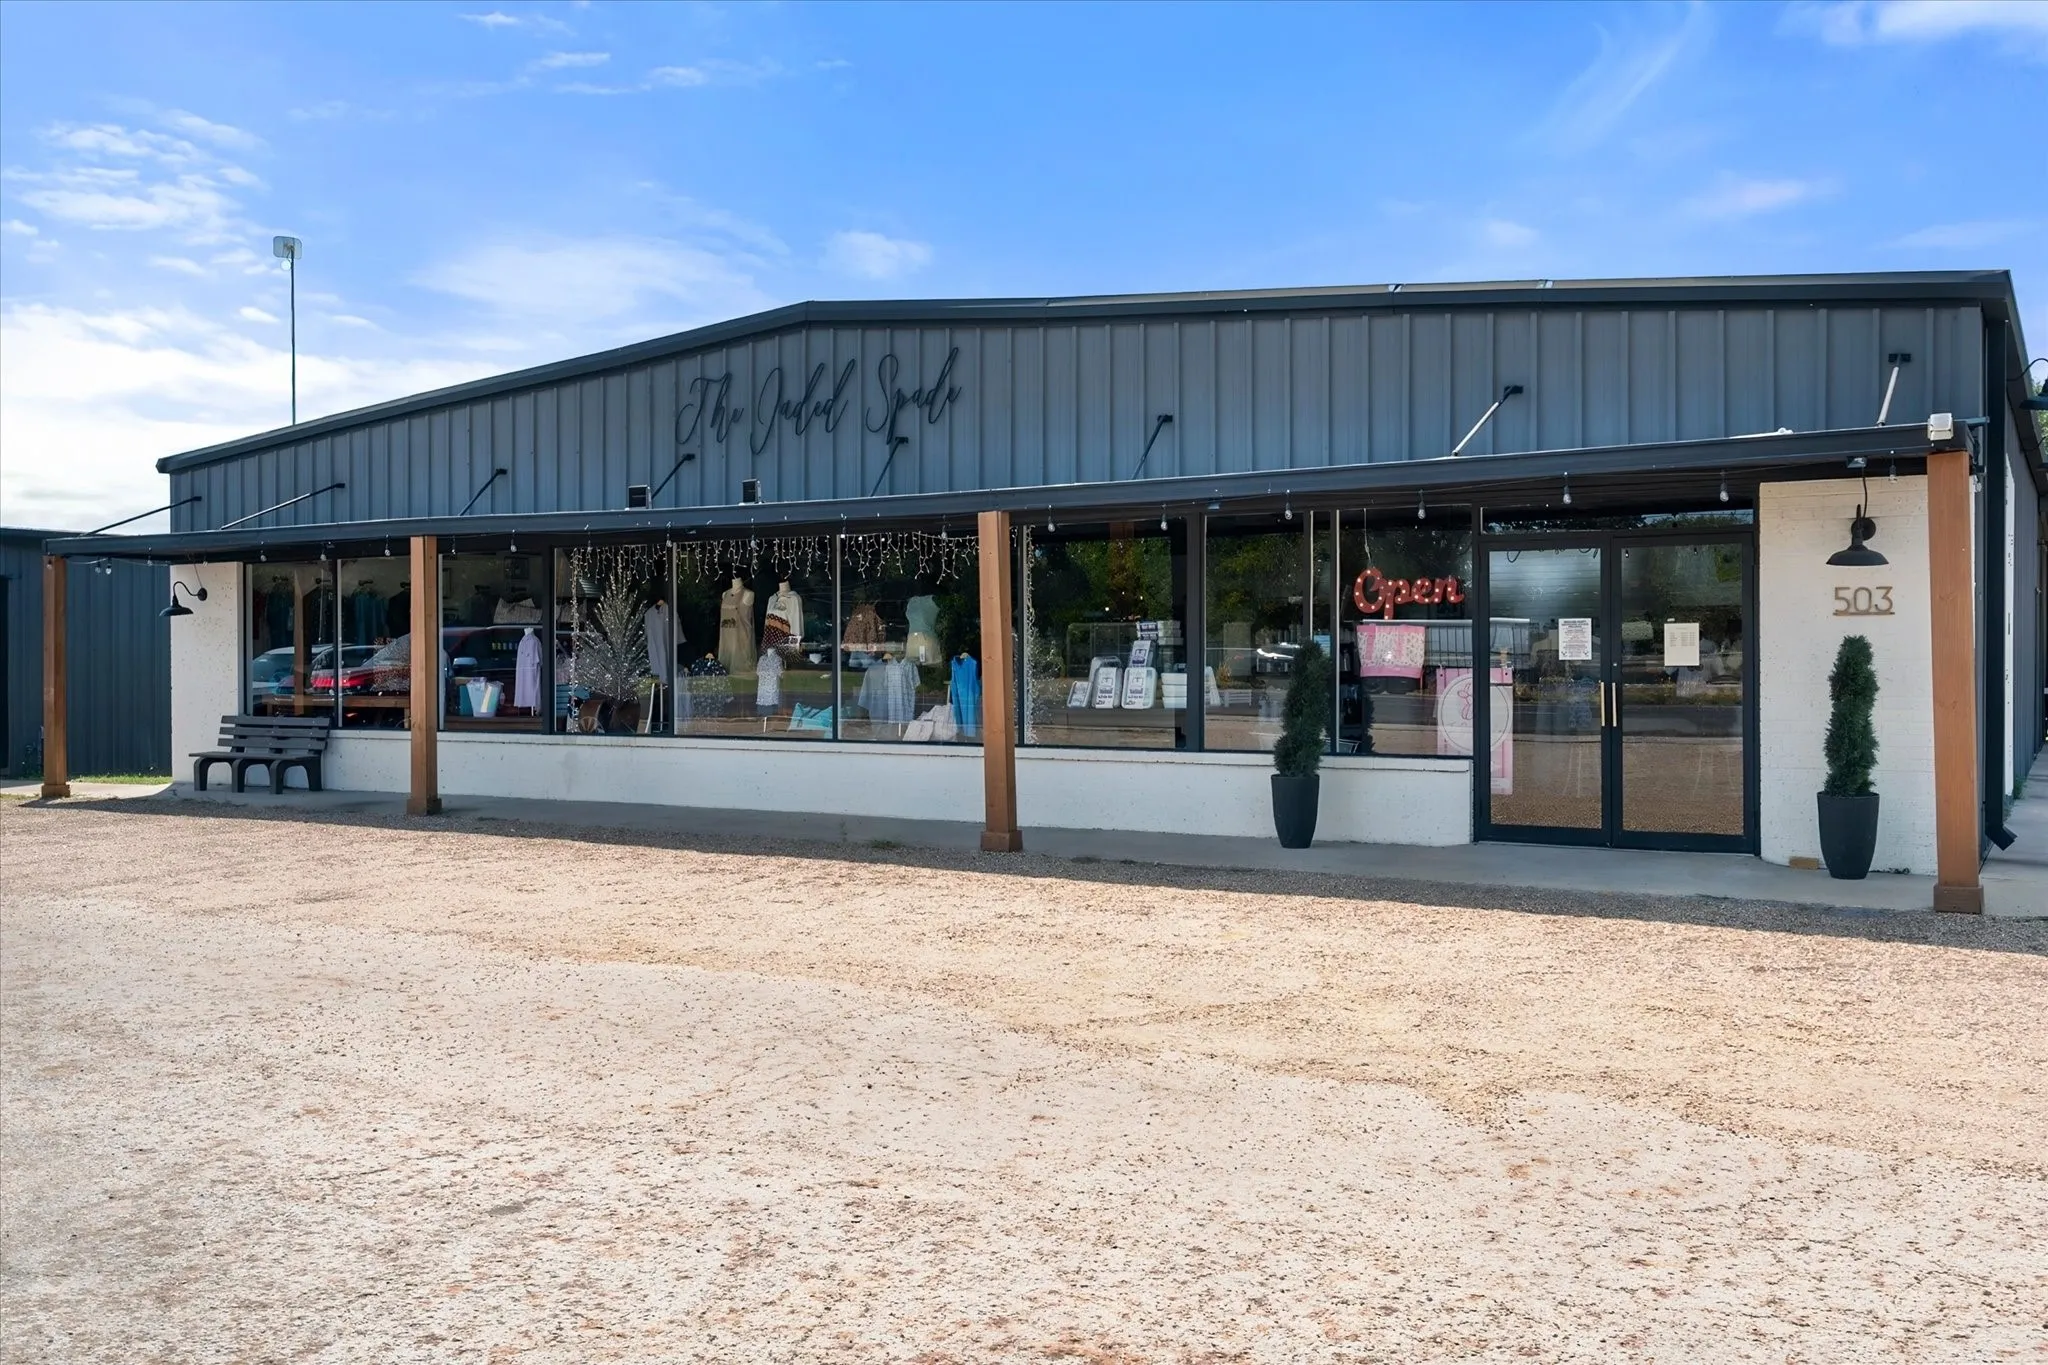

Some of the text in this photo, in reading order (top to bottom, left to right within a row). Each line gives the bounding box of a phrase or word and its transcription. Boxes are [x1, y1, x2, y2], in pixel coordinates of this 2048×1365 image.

[675, 347, 962, 455] The Jaded Spade
[1353, 567, 1465, 621] Open
[1834, 586, 1894, 614] 503
